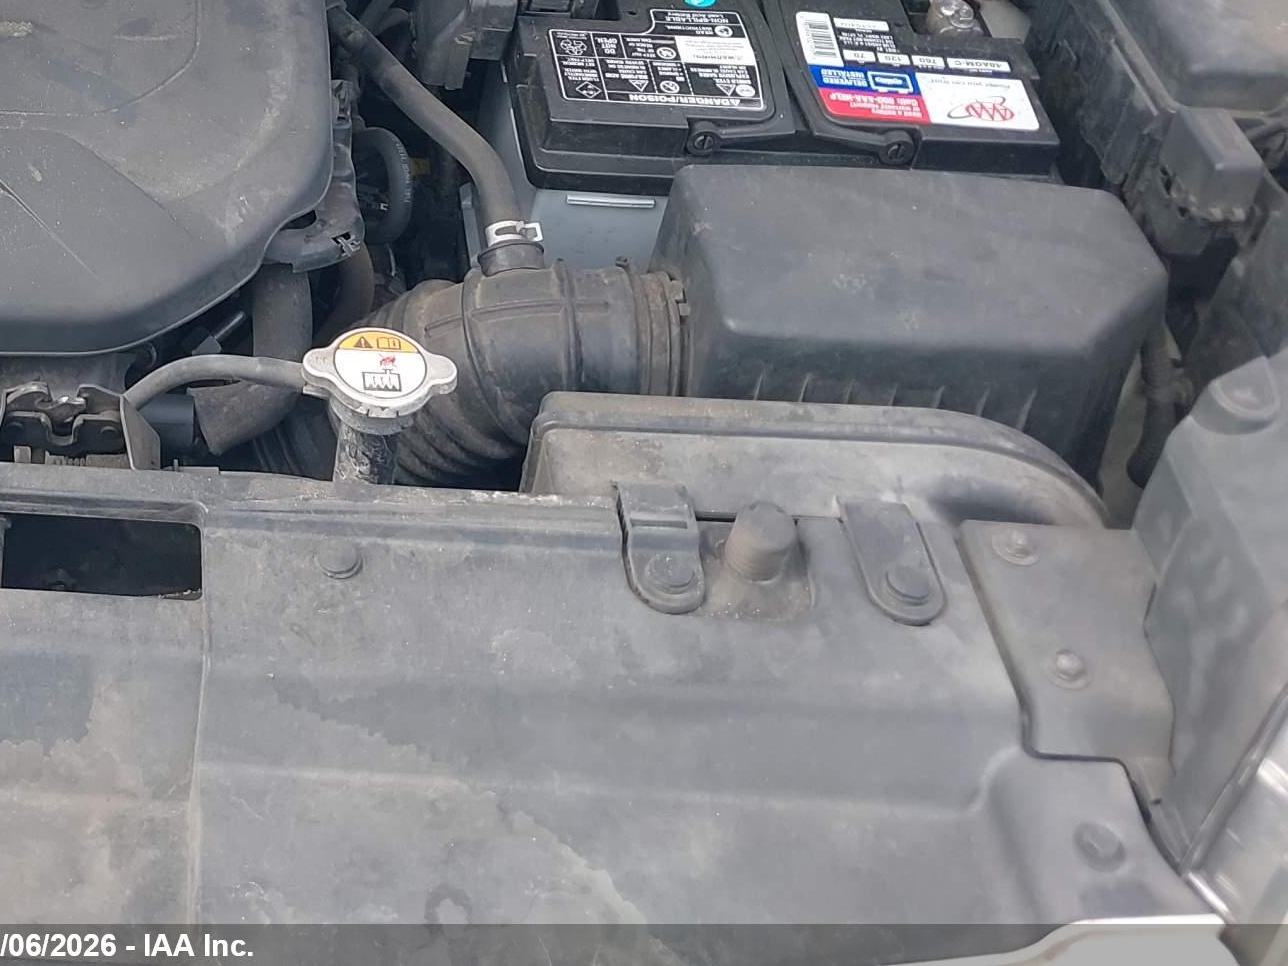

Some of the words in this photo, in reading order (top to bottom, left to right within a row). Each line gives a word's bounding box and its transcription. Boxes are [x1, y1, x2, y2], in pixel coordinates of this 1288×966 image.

[821, 69, 865, 78] INSTALLED
[823, 78, 868, 87] DELIVERED
[966, 101, 1015, 122] AAA
